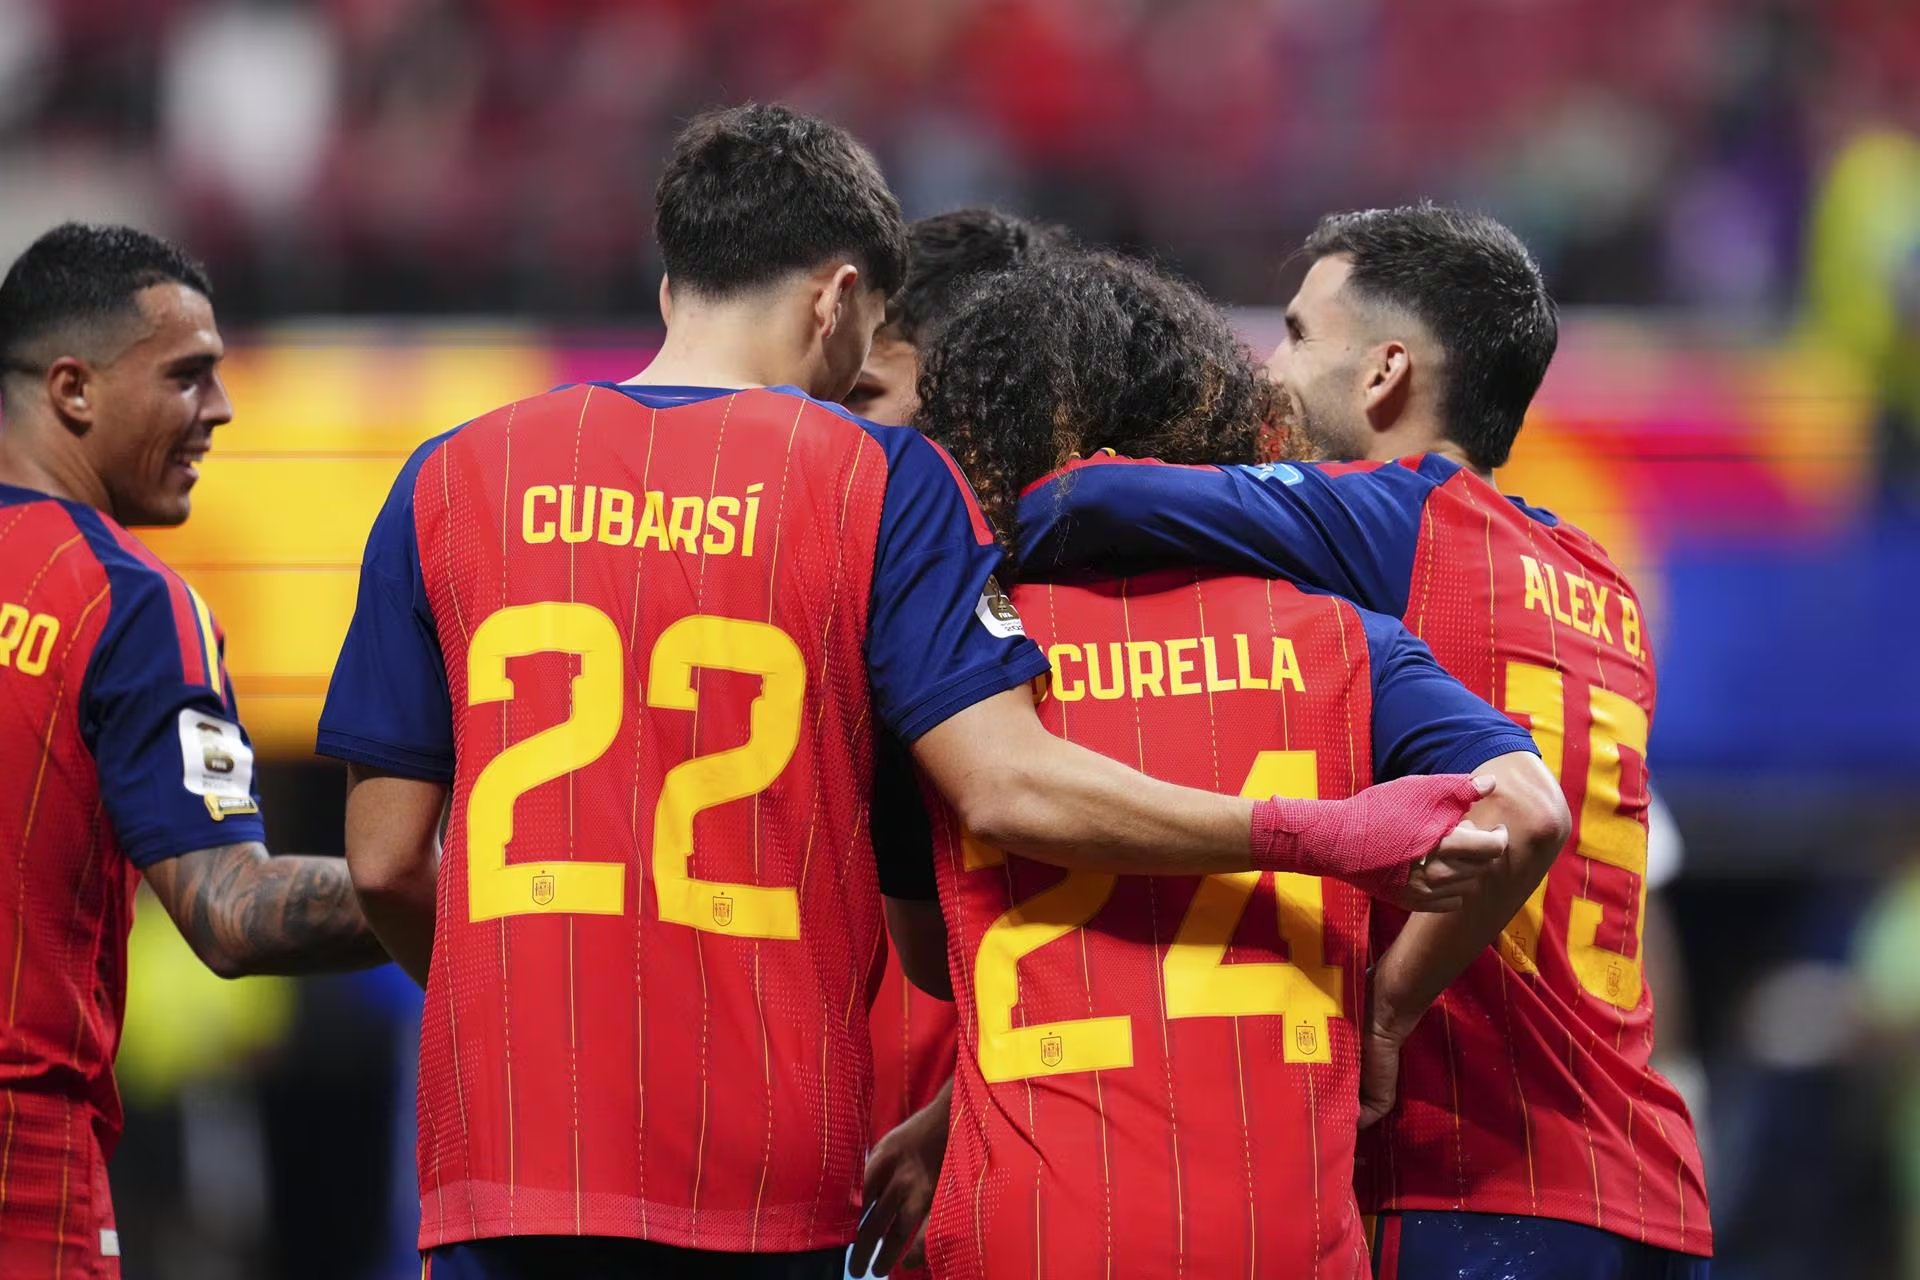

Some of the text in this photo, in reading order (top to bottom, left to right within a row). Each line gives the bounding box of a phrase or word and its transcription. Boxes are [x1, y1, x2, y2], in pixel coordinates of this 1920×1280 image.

[522, 482, 764, 557] CUBARSÍ
[0, 602, 60, 677] RO
[1520, 554, 1646, 662] ALEX B.
[1032, 633, 1306, 702] CURELLA
[467, 601, 806, 940] 22
[1503, 661, 1648, 1011] 15
[961, 750, 1344, 1083] 24
